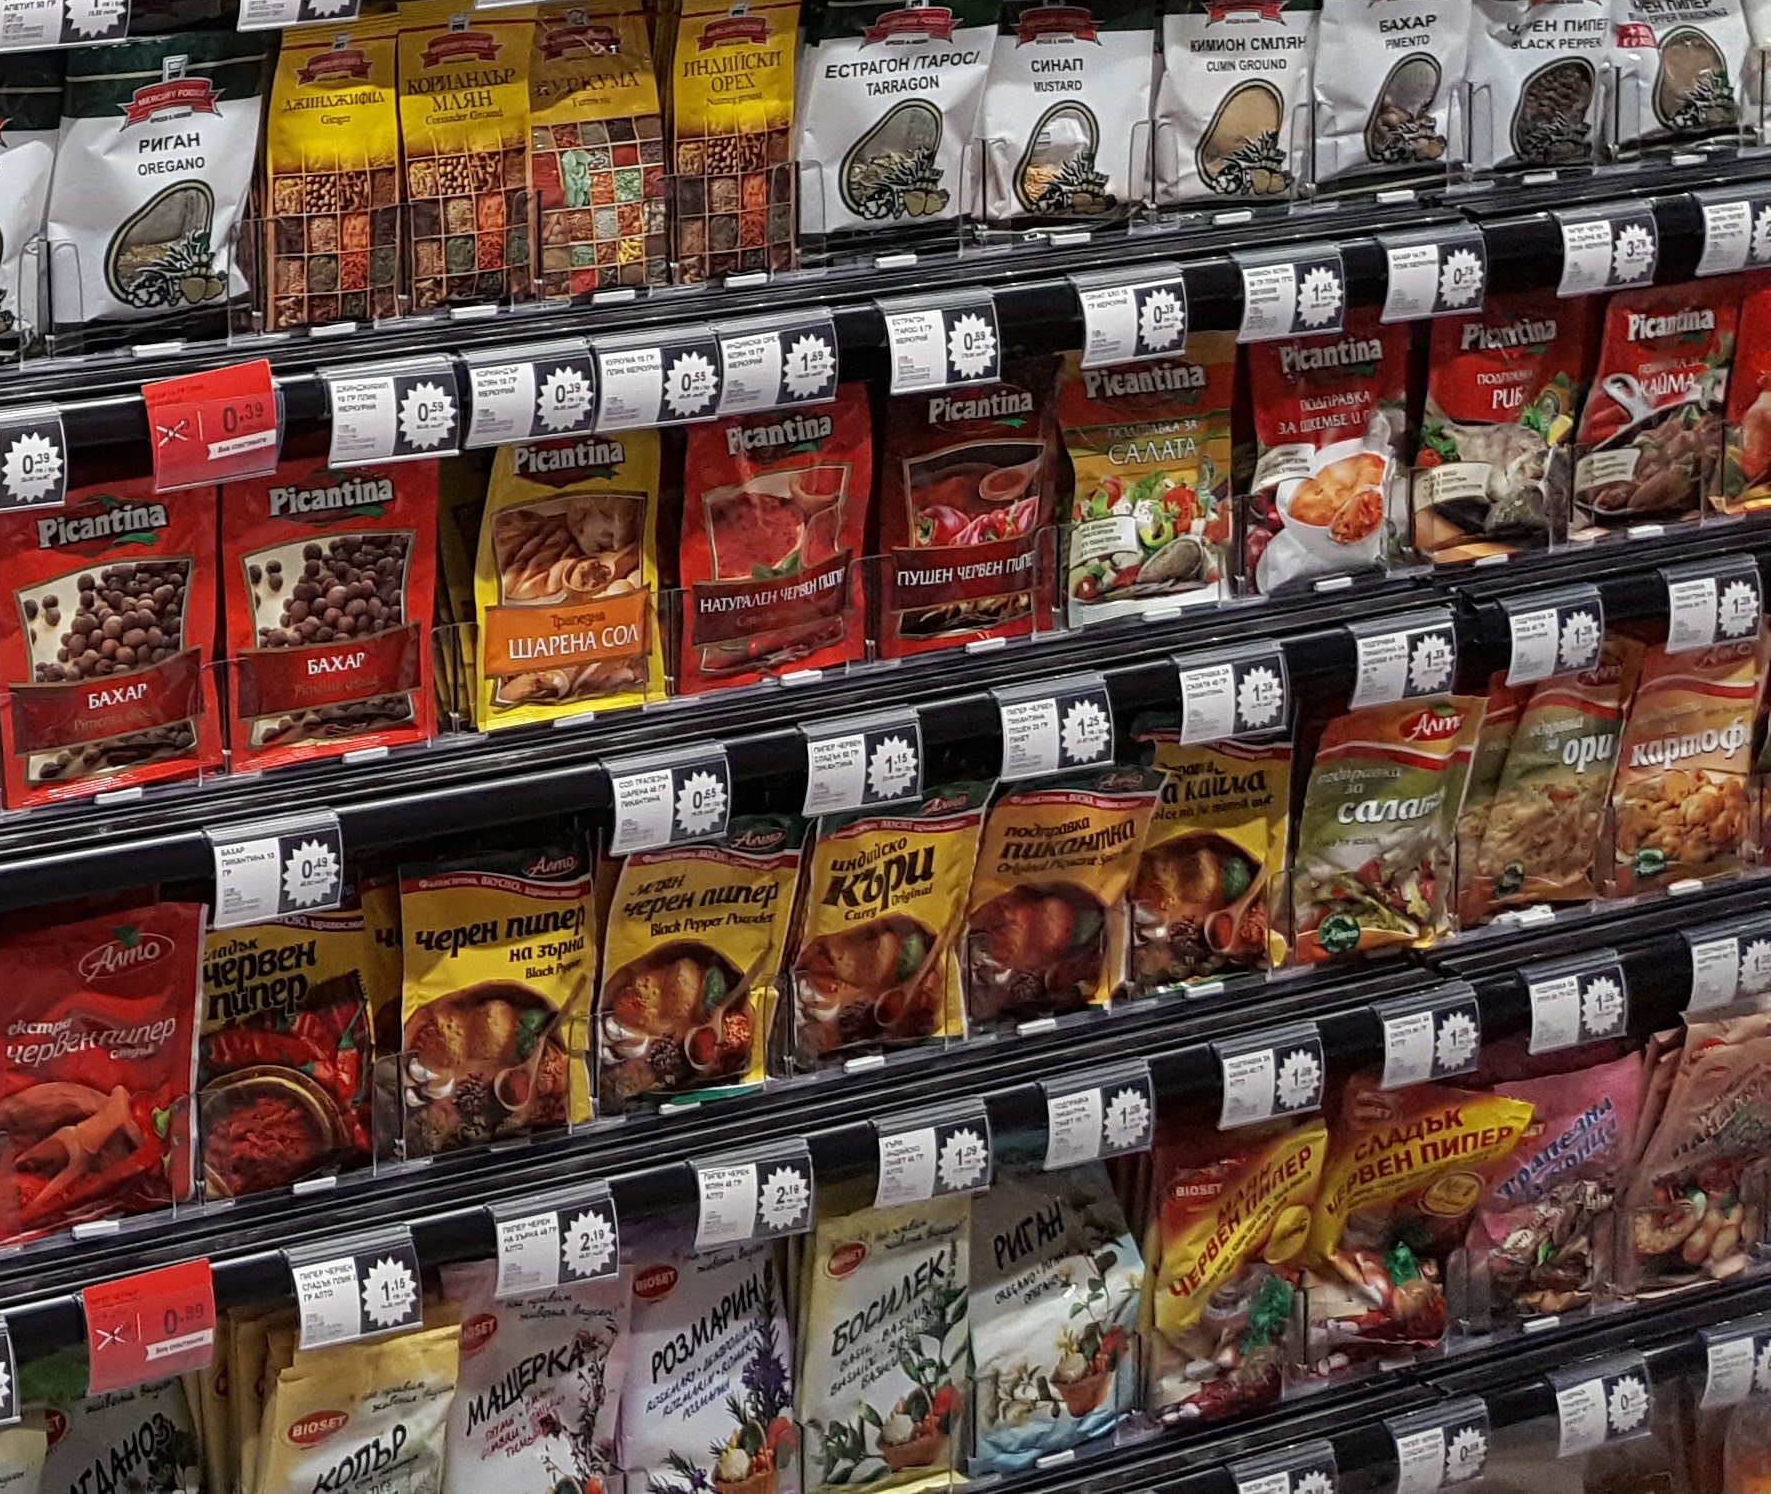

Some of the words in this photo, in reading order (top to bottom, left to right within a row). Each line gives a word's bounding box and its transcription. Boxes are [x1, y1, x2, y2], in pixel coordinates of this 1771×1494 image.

[1379, 14, 1437, 33] БАХАР
[825, 56, 909, 79] ЕСТРАГОН
[1031, 58, 1084, 73] СИНАП
[866, 75, 939, 97] TARRAGON
[1034, 79, 1083, 92] MUSTARD
[138, 133, 201, 154] РИГАН
[138, 156, 205, 175] OREGANO
[929, 392, 1033, 424] Picantina
[37, 503, 167, 550] Picantina
[897, 565, 953, 587] ПУШЕН
[958, 558, 1002, 581] ЧЕРВЕН
[307, 651, 365, 676] БАХАР
[823, 847, 935, 909] къри
[416, 915, 497, 959] черен
[505, 906, 585, 941] пипер
[204, 939, 317, 987] червен
